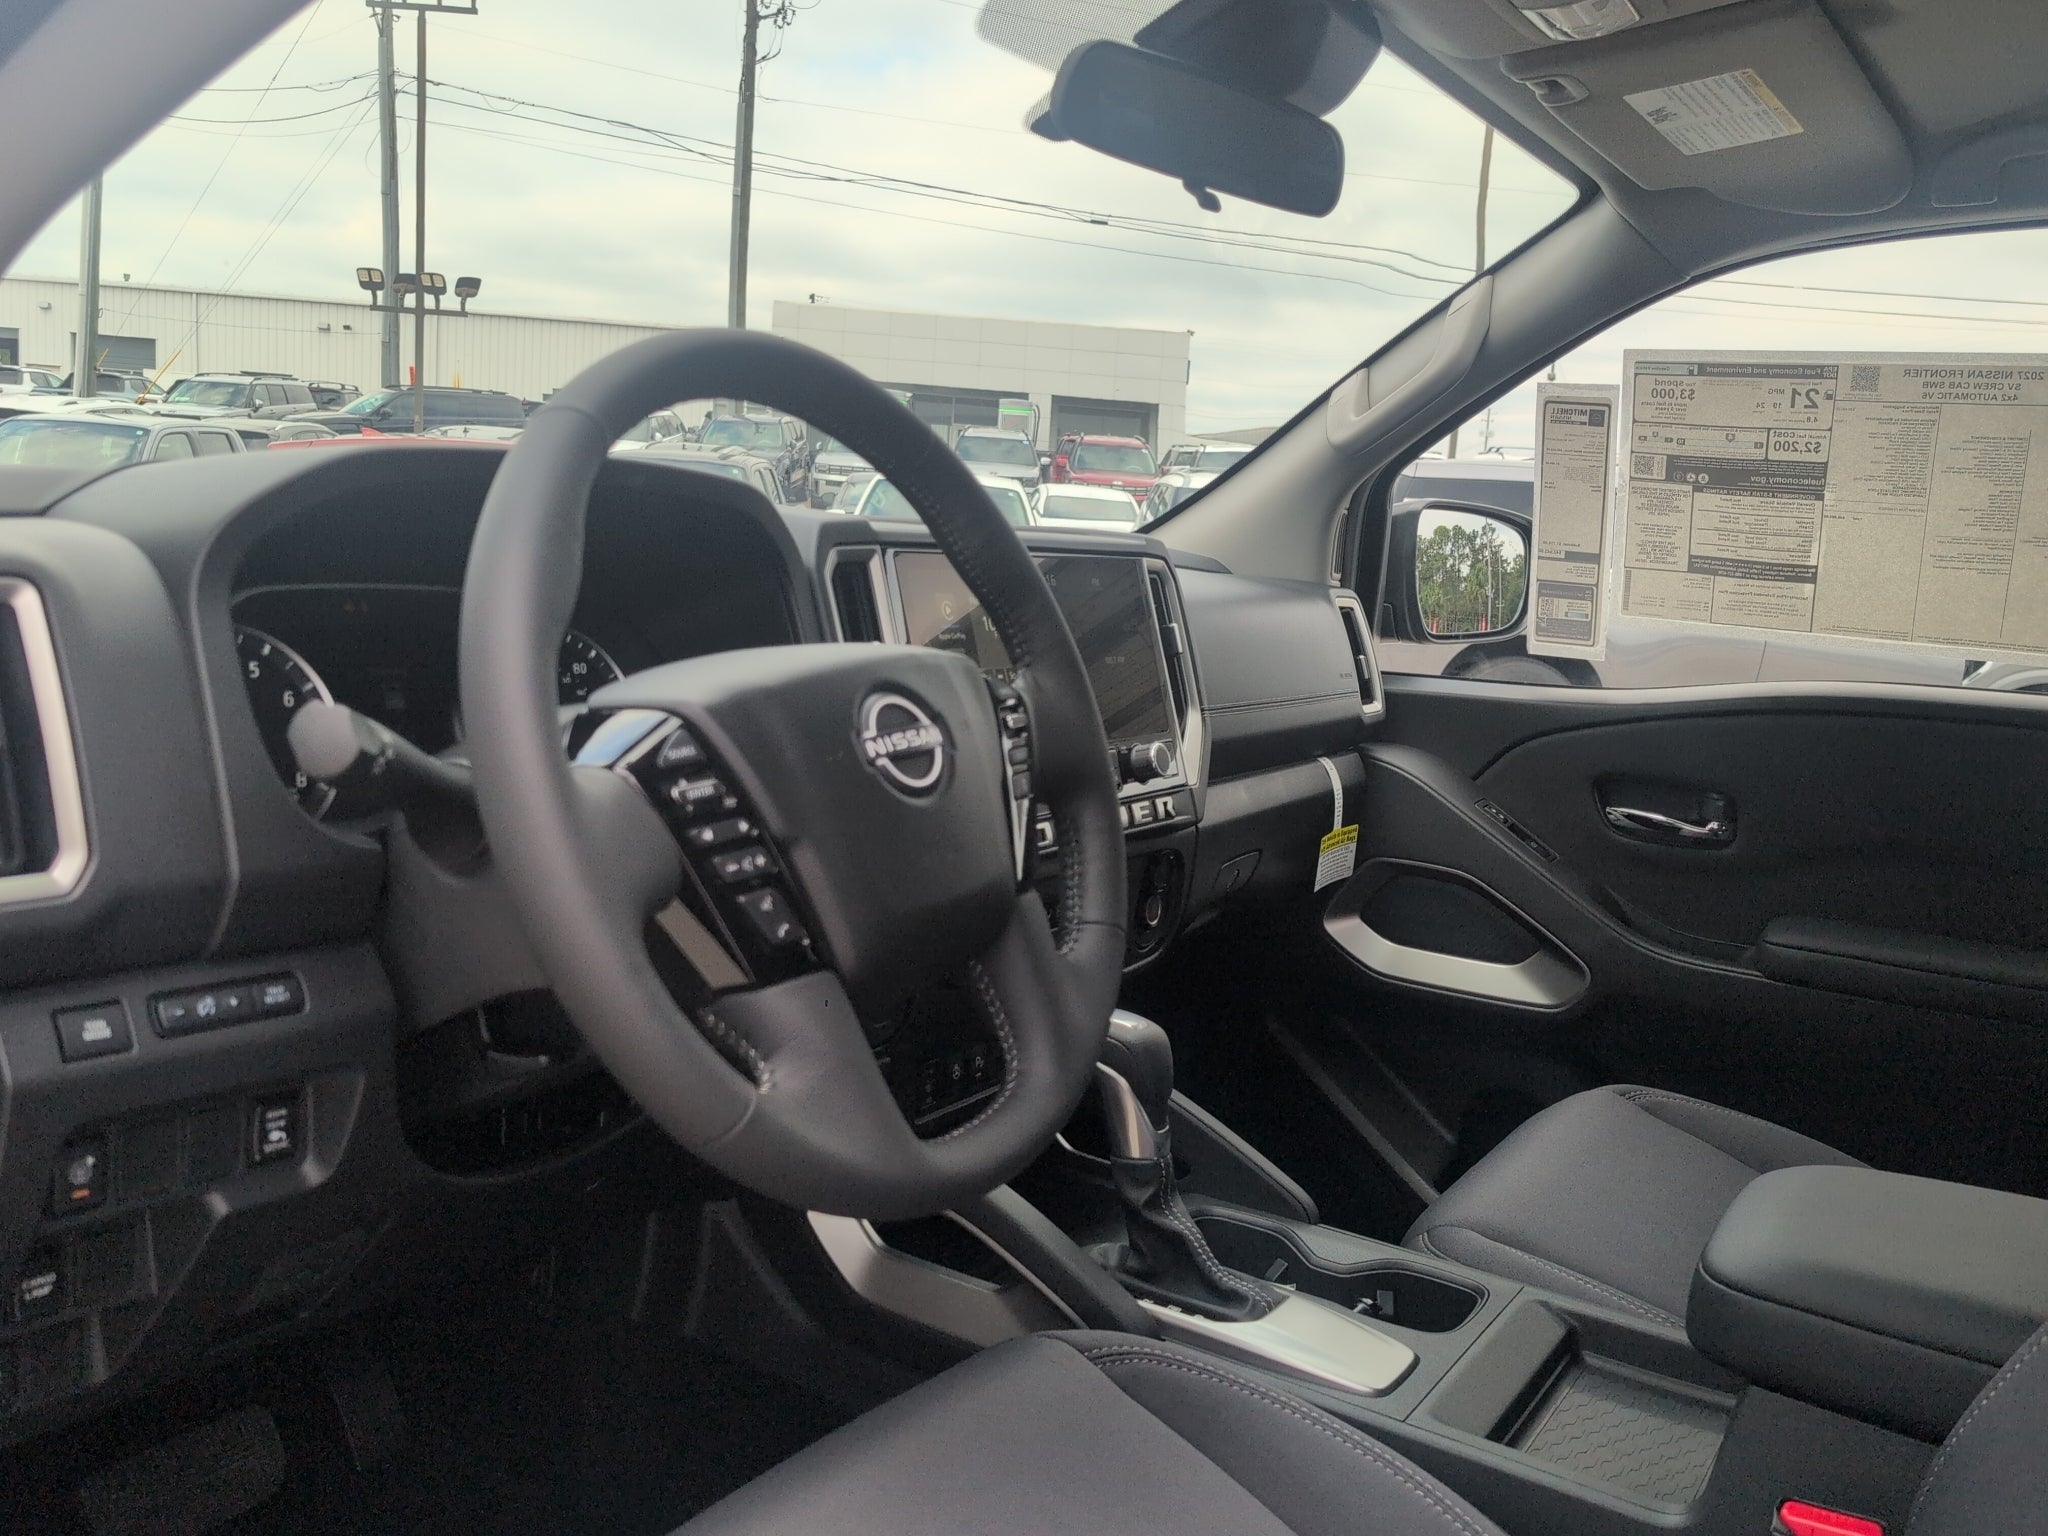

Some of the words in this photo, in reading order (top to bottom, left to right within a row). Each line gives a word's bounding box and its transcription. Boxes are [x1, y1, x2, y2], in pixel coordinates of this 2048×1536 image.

[248, 661, 260, 679] 5
[572, 662, 587, 674] 80
[283, 691, 294, 708] 6
[864, 723, 943, 760] NISSAN
